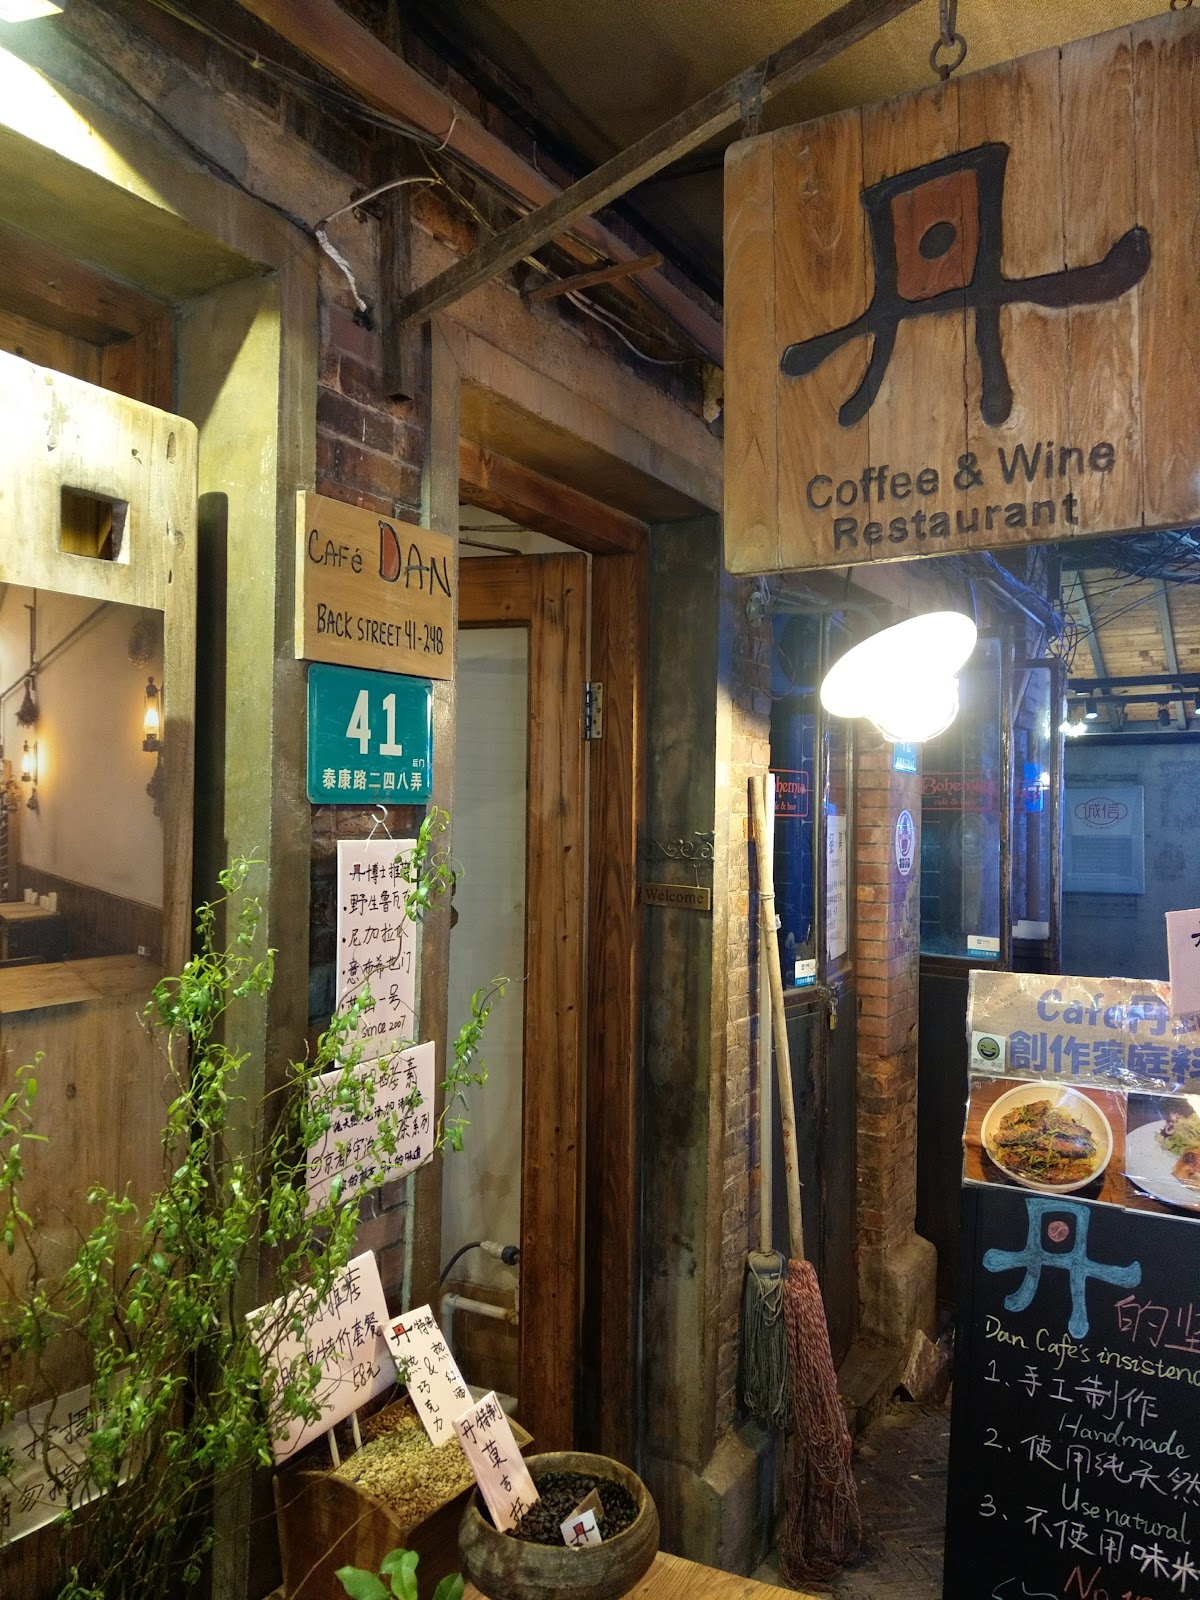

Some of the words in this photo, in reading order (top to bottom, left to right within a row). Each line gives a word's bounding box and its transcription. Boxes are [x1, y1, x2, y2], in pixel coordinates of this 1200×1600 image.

[806, 463, 939, 511] Coffee
[953, 452, 983, 489] &
[998, 440, 1116, 483] Wine
[832, 492, 1079, 550] Restaurant
[378, 519, 451, 598] DAN
[316, 602, 353, 640] BACK
[357, 617, 401, 648] STREET
[404, 619, 444, 656] 41-248
[345, 689, 403, 757] 41
[321, 766, 423, 792] 泰康路二四八弄
[411, 757, 426, 769] 后门
[1083, 803, 1120, 819] 诚信
[645, 887, 705, 905] Welcome
[389, 1014, 407, 1030] 2007
[985, 1314, 1030, 1350] Dan
[424, 1356, 439, 1376] &
[1058, 1413, 1191, 1460] Handmade
[1061, 1483, 1100, 1519] Use
[1105, 1511, 1191, 1545] natural
